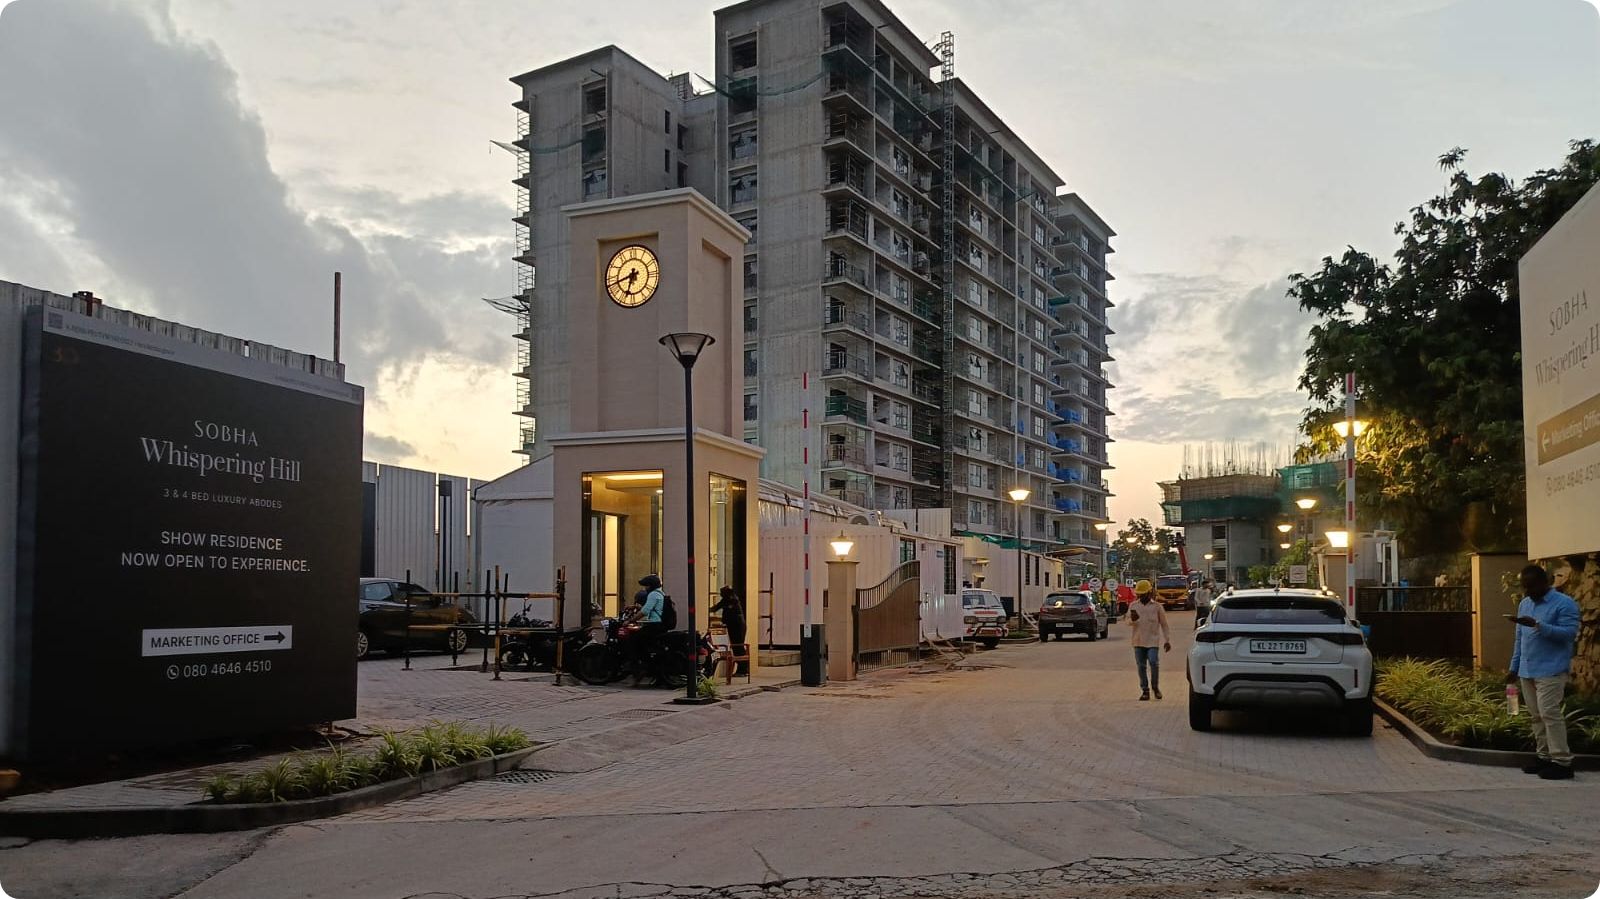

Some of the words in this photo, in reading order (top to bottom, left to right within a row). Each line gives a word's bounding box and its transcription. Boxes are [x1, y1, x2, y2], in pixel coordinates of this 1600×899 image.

[1549, 289, 1588, 336] SOBHA
[1589, 321, 1600, 355] H
[194, 420, 259, 447] SOBHA
[139, 436, 266, 484] Whispering
[269, 456, 302, 482] Hill
[163, 488, 170, 498] 3
[172, 488, 180, 498] &
[182, 489, 188, 499] 4
[191, 491, 209, 501] BED
[212, 494, 247, 505] LUXURY
[250, 498, 283, 509] ABODES
[161, 530, 206, 546] SHOW
[210, 533, 283, 551] RESIDENCE
[121, 552, 160, 567] NOW
[164, 554, 205, 569] OPEN
[209, 555, 228, 569] TO
[232, 556, 312, 572] EXPERIENCE.
[151, 635, 220, 649] MARKETING
[222, 633, 261, 646] OFFICE
[183, 664, 208, 678] 080
[211, 662, 242, 676] 4646
[245, 660, 272, 673] 4510
